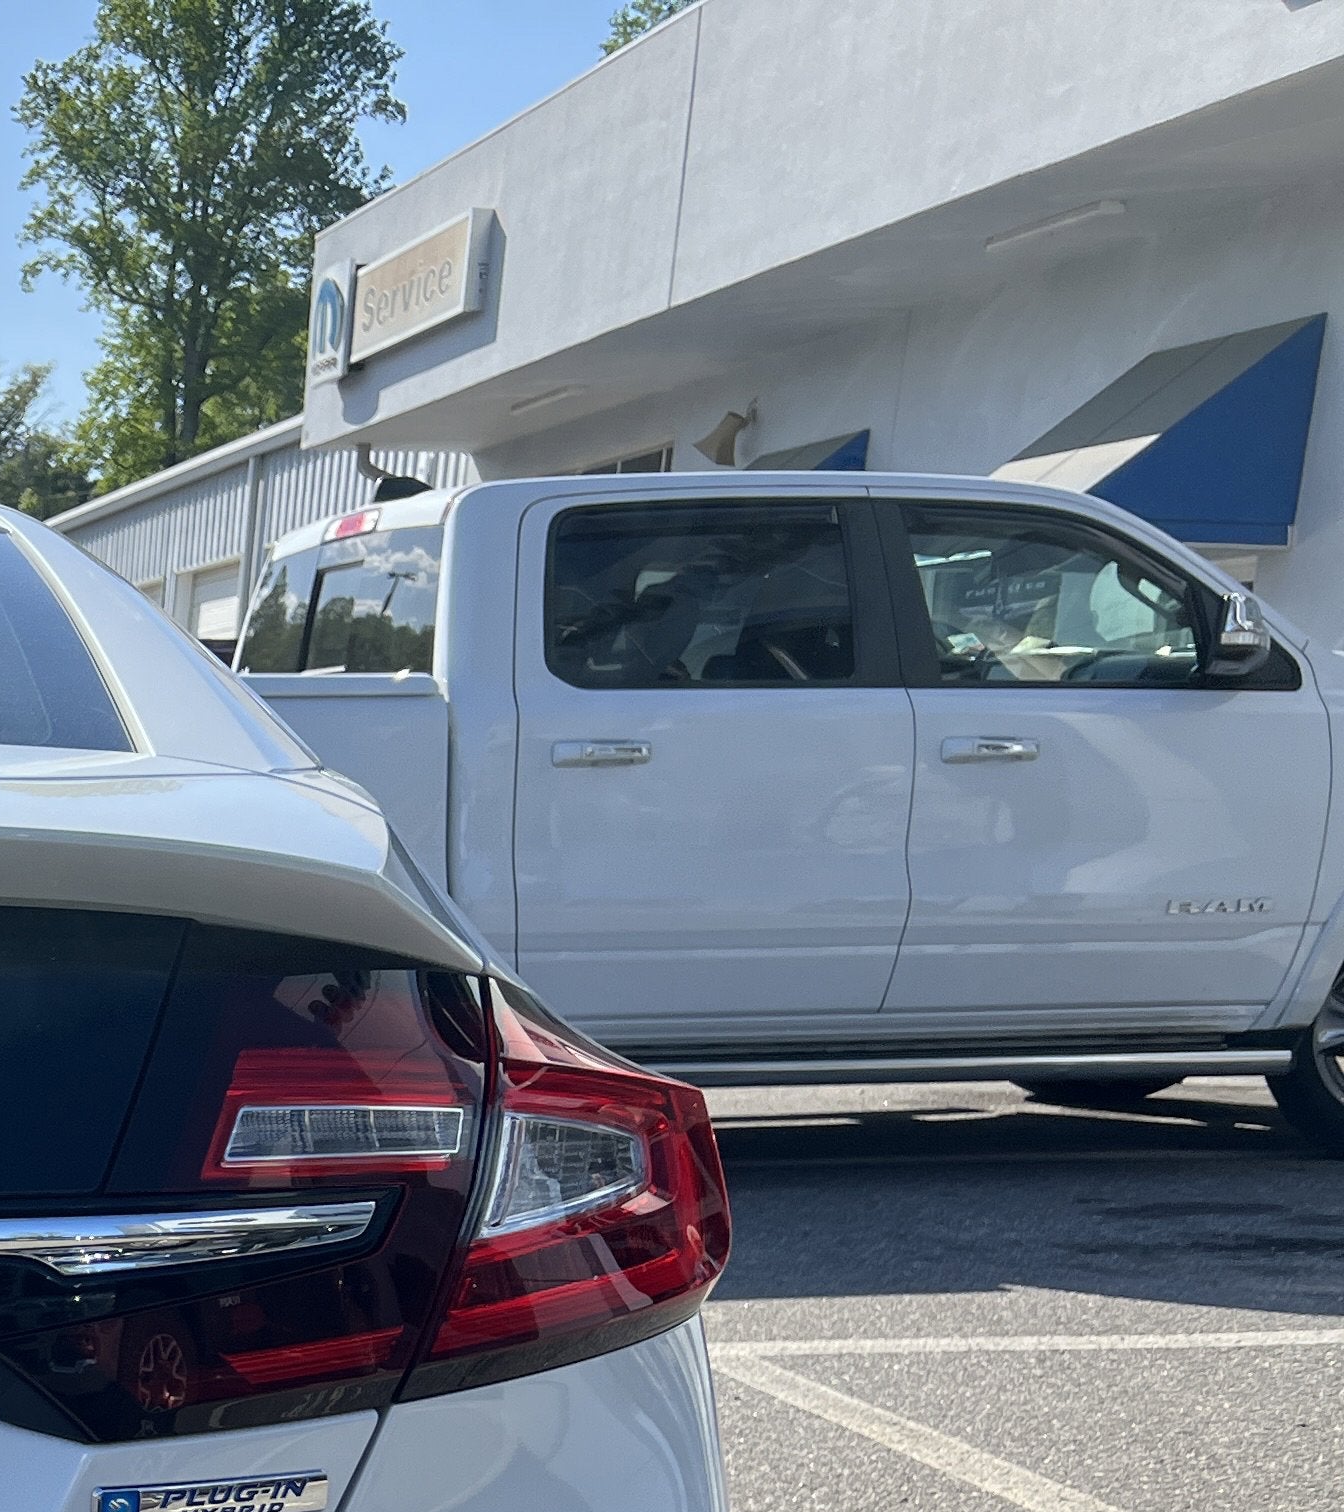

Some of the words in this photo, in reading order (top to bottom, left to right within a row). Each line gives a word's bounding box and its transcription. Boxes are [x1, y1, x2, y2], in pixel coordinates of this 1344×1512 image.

[361, 257, 453, 334] Service
[1167, 897, 1272, 914] RAM
[159, 1478, 309, 1509] PLUG-IN
